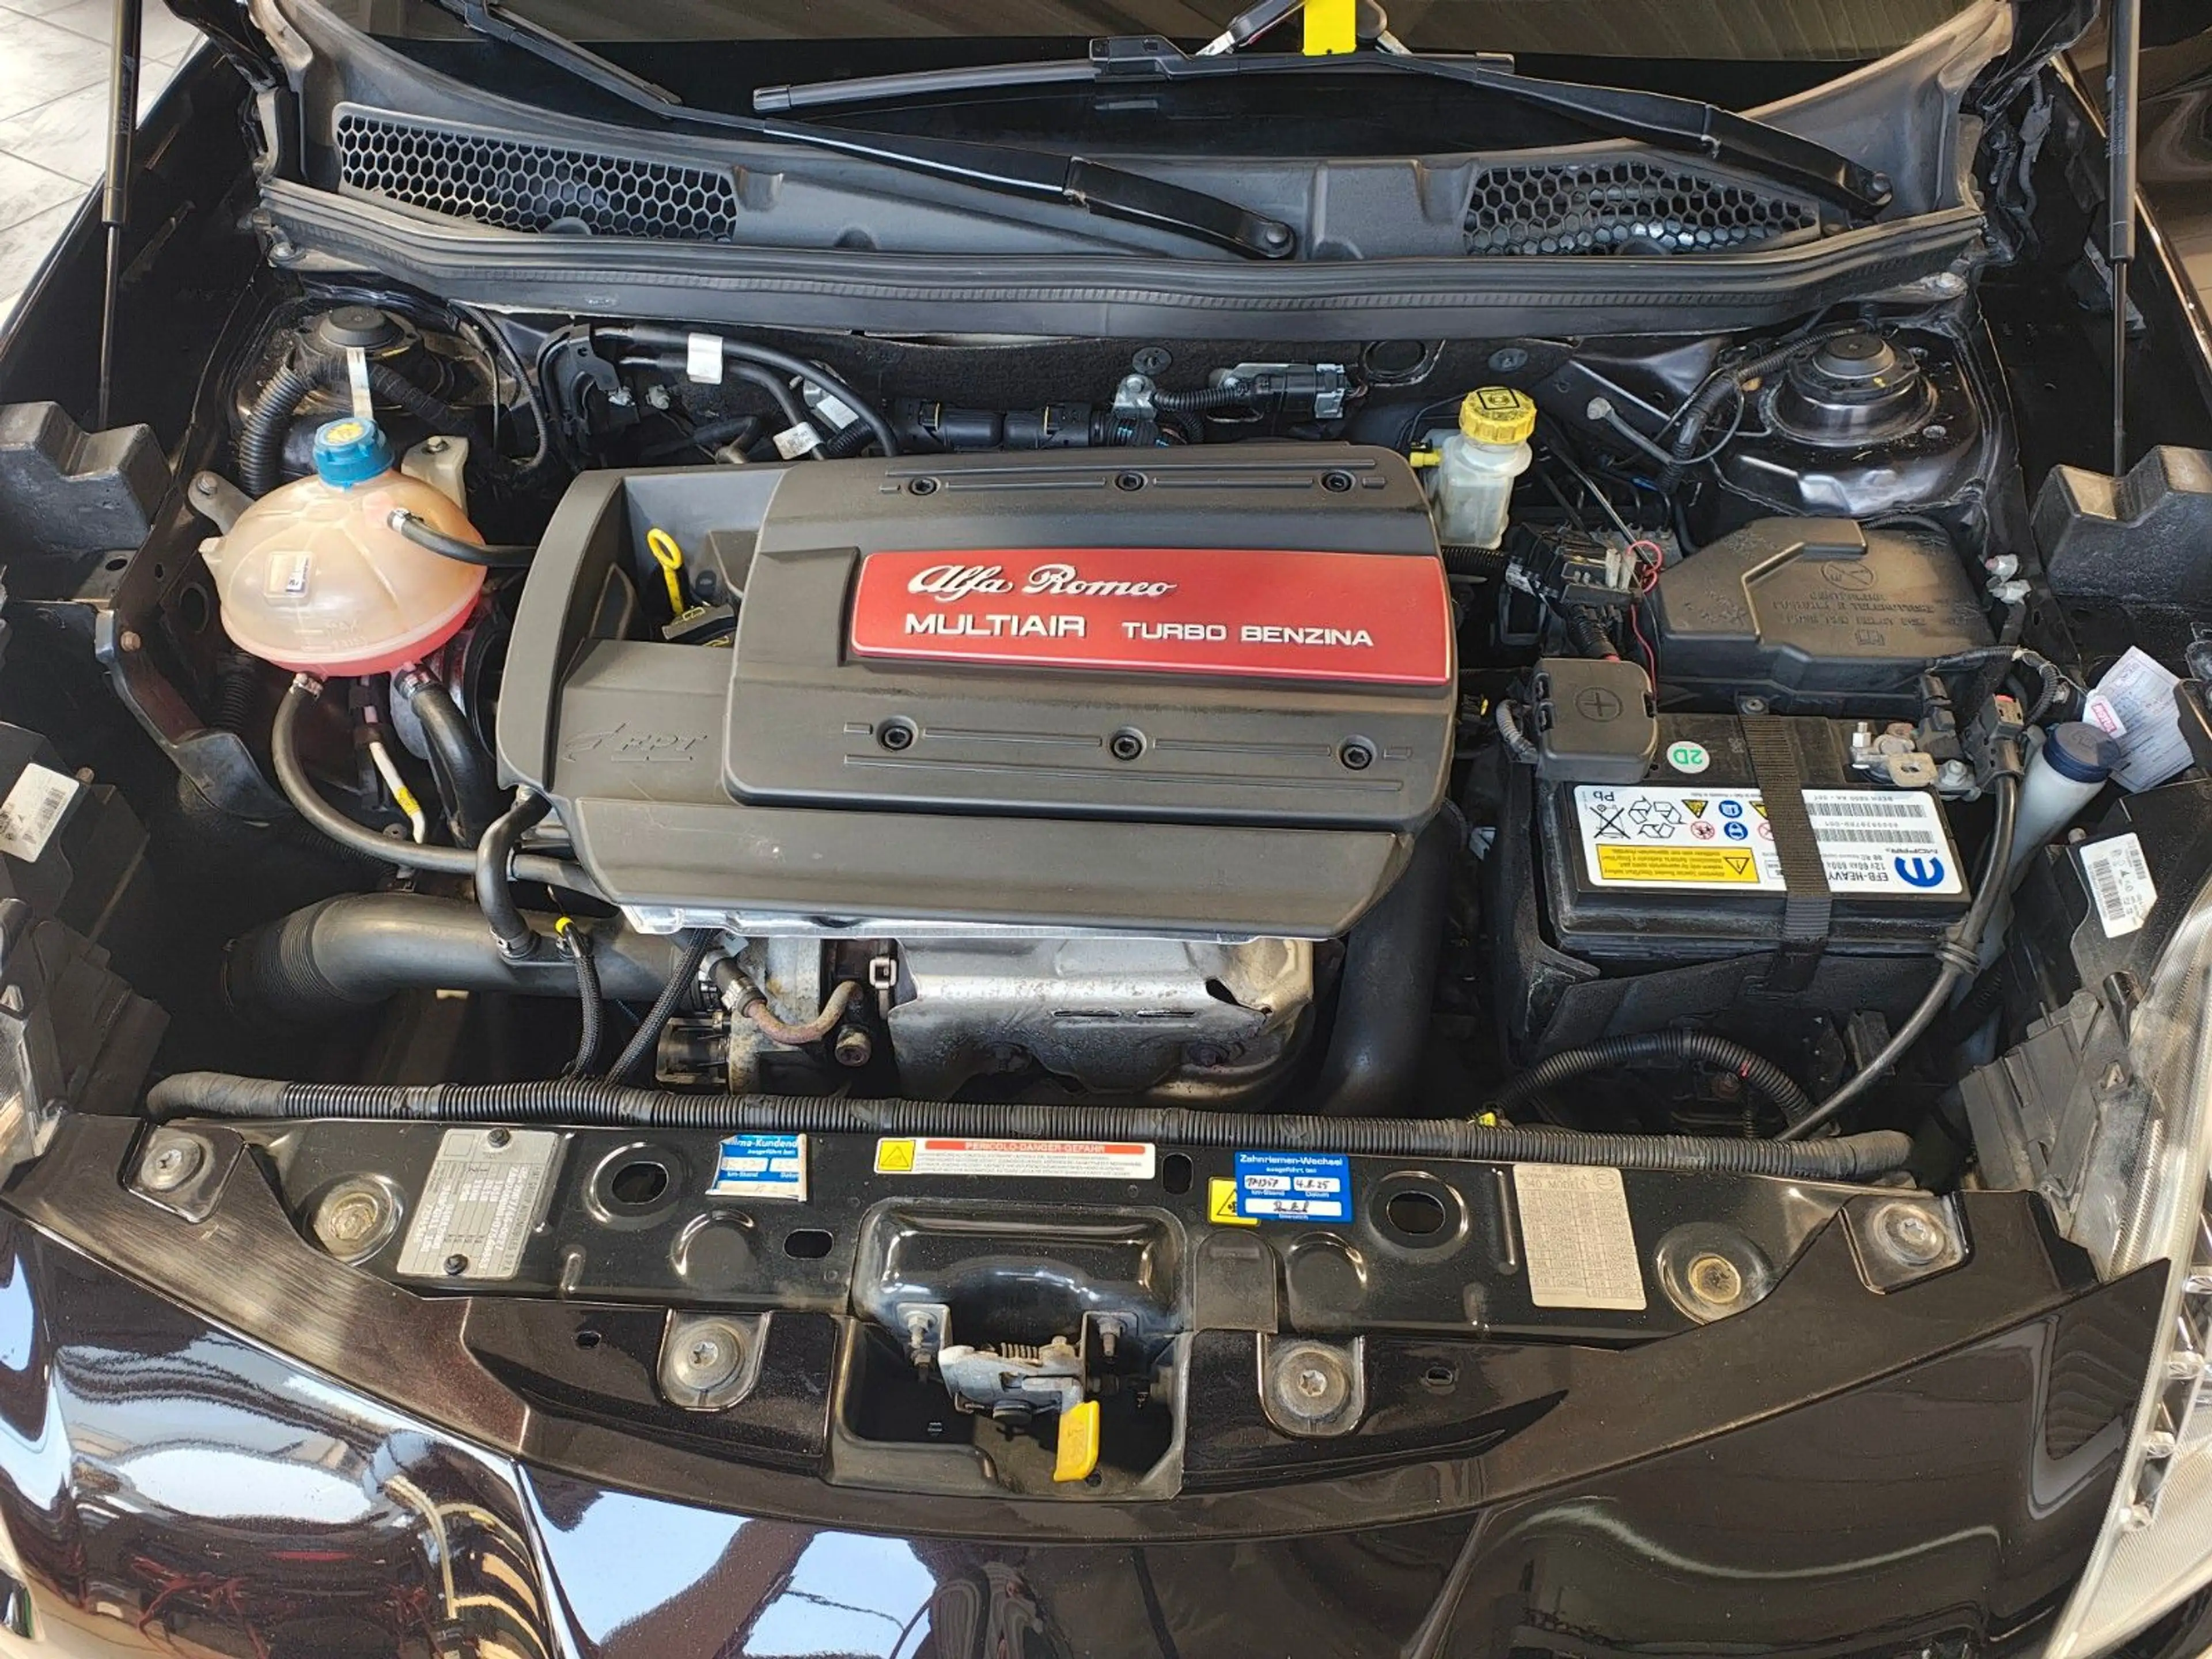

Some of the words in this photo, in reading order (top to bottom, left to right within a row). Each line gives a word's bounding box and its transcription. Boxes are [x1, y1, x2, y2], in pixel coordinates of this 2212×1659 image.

[907, 564, 1013, 602] Alfa
[1021, 563, 1178, 597] Romeo
[905, 613, 1086, 637] MULTIAIR
[1121, 622, 1228, 641] TURBO
[1240, 625, 1374, 647] BENZINA
[1672, 748, 1703, 765] 2D
[1593, 790, 1615, 802] Pb
[1828, 871, 1889, 882] EFB-HEAVY
[1240, 1154, 1343, 1166] Zahnriemen-Wechsel
